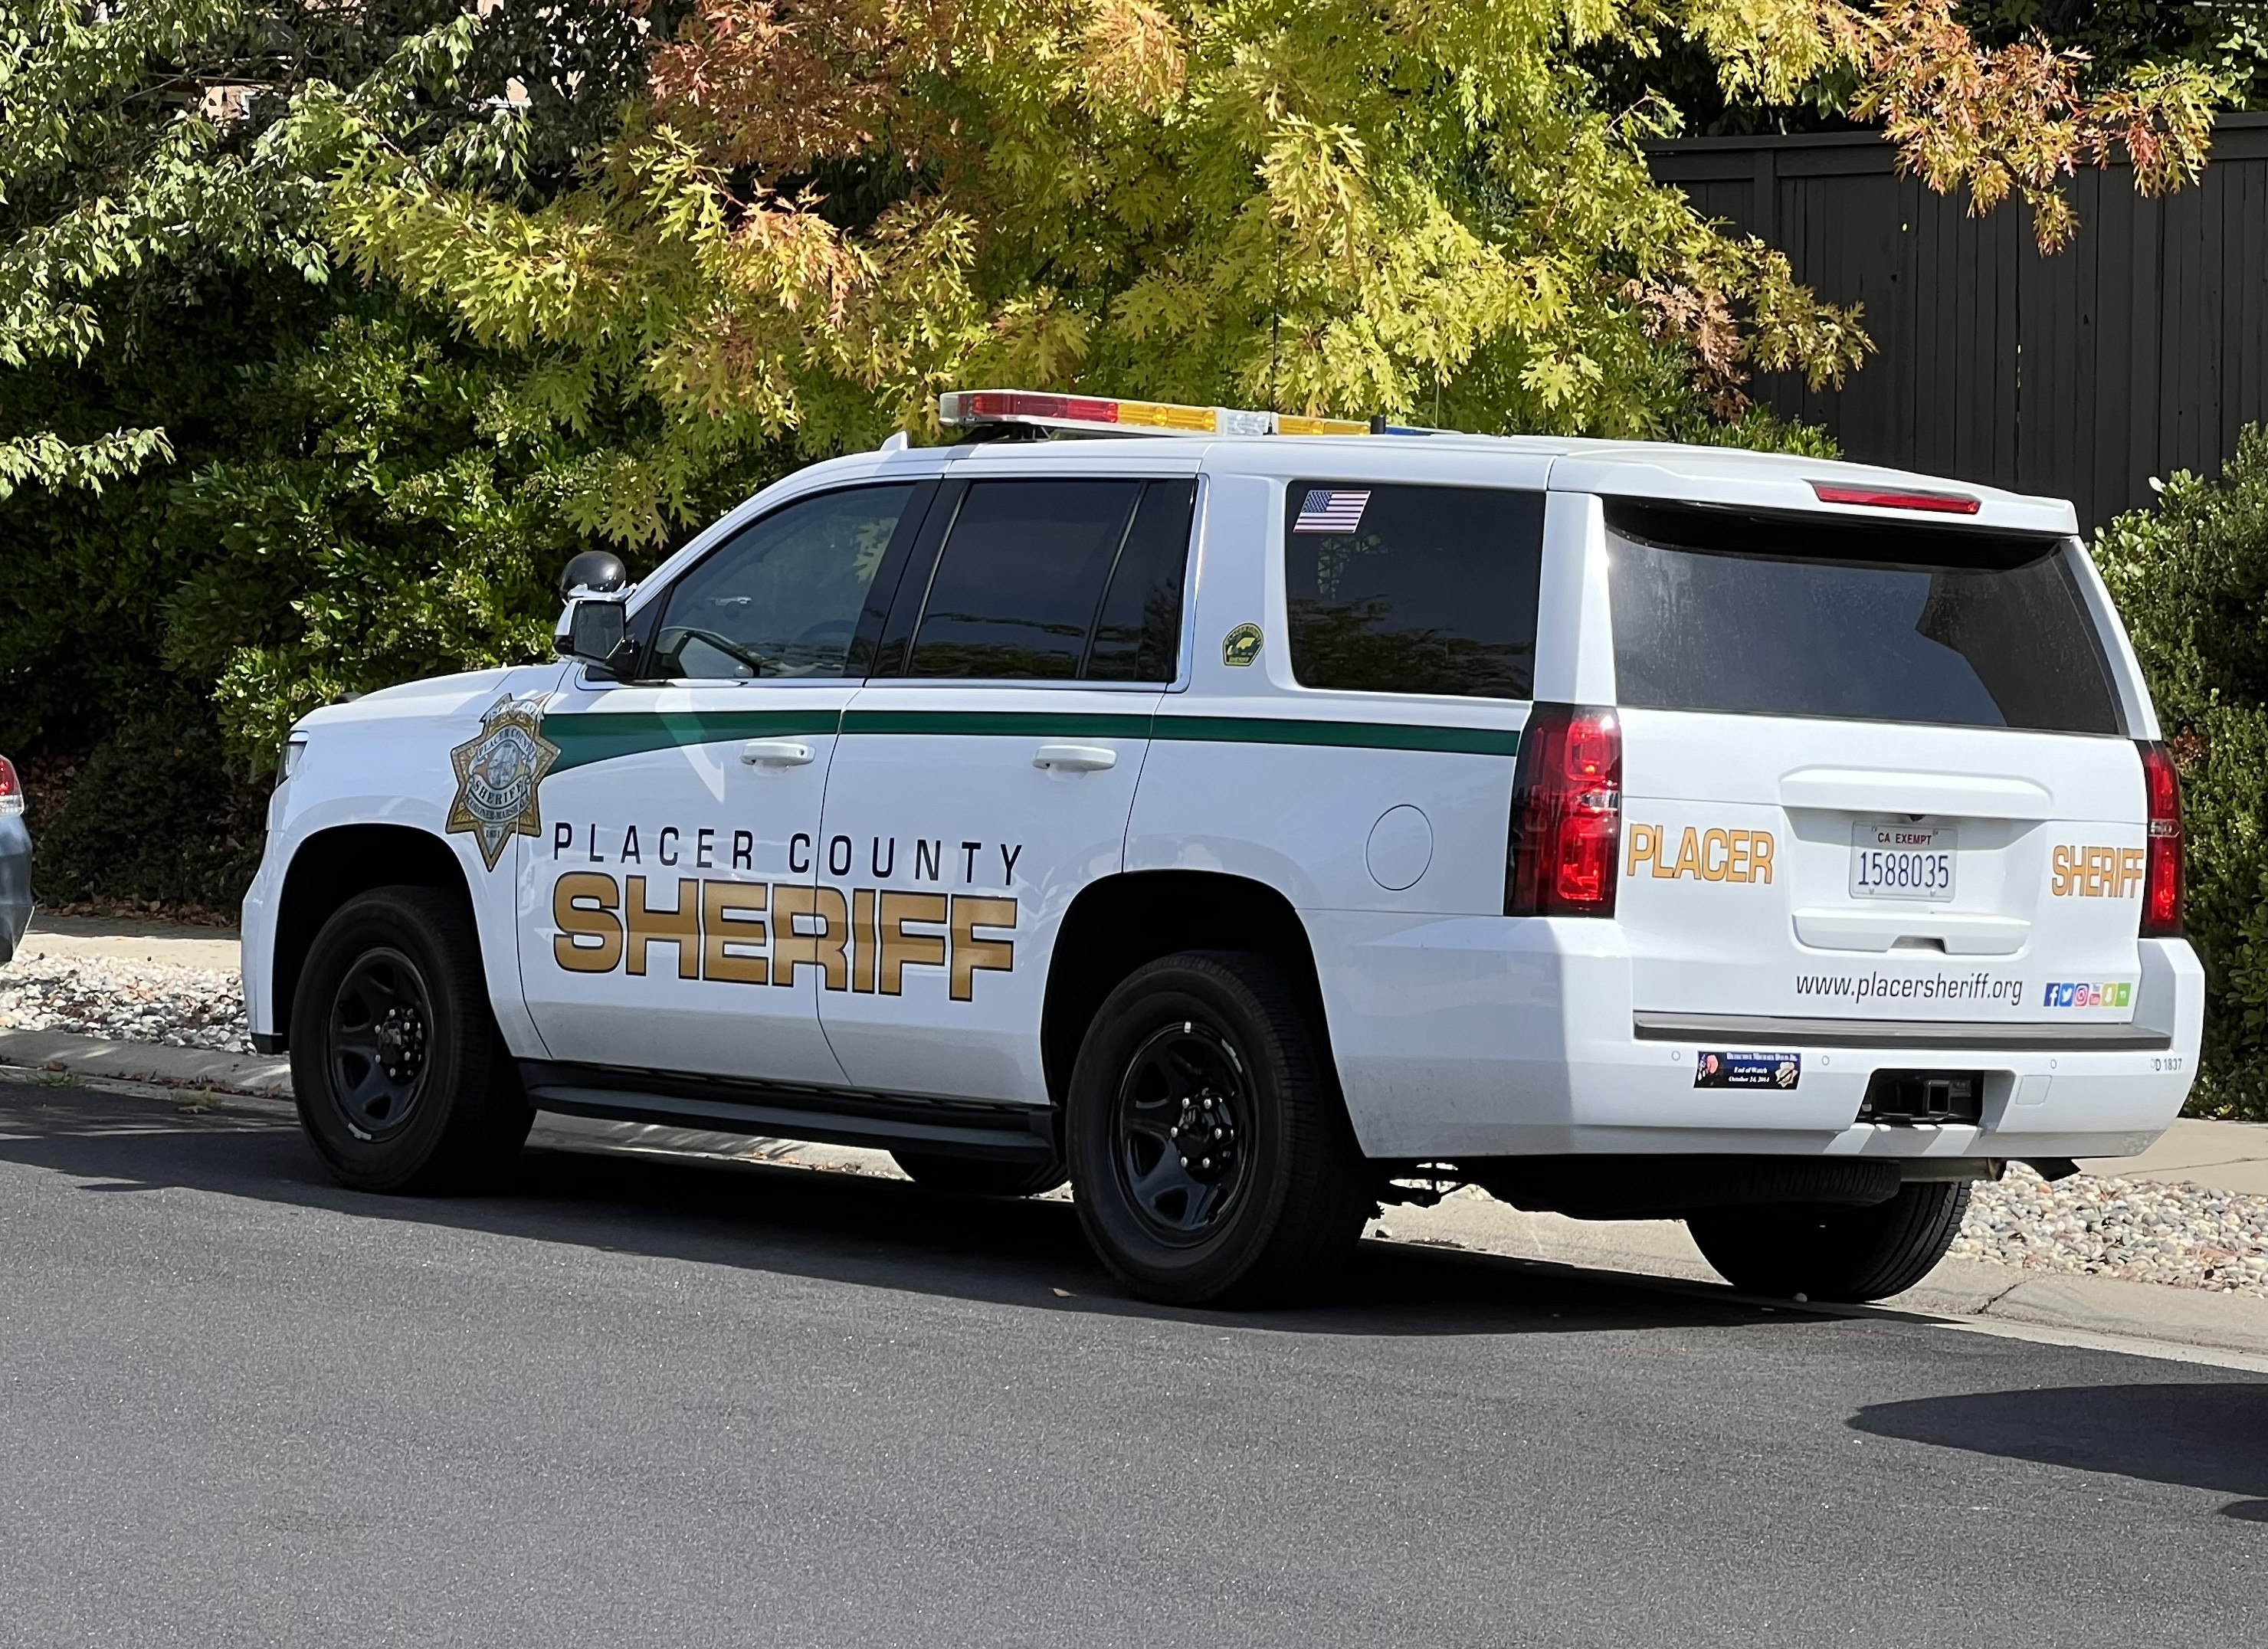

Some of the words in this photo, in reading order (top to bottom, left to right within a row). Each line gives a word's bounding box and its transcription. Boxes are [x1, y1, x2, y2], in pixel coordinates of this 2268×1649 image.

[477, 729, 510, 756] PLACER
[474, 780, 523, 805] SHERIFF
[554, 822, 753, 870] PLACER
[788, 832, 1022, 885] COUNTY
[1627, 824, 1775, 884] PLACER
[1877, 832, 1890, 843] CA
[1896, 834, 1932, 845] EXEMPT
[1858, 851, 1948, 888] 1588035
[2052, 845, 2144, 898] SHERIFF
[553, 871, 1018, 1002] SHERIFF
[1797, 972, 2023, 1006] www.placersheriff.org
[2164, 1058, 2182, 1070] 1837
